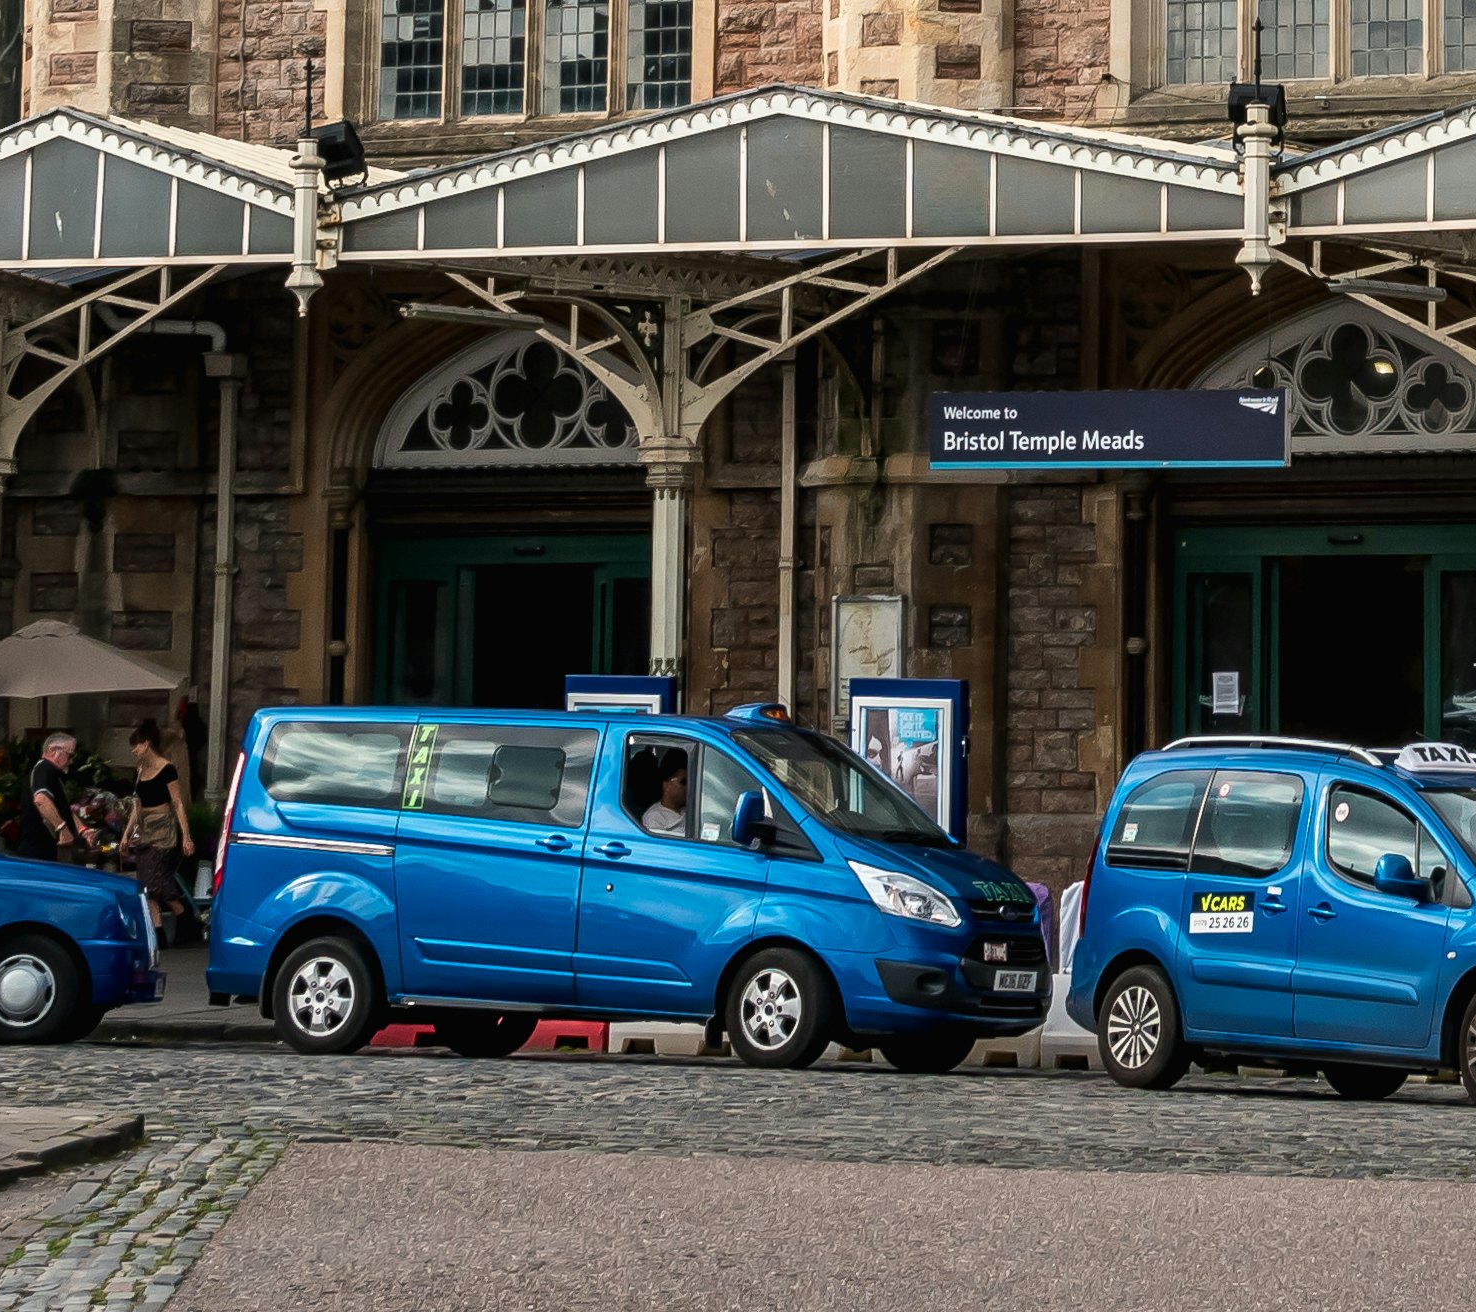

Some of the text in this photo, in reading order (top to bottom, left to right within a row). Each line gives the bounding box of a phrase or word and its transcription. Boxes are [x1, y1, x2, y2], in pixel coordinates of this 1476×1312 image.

[943, 406, 1018, 420] Welcome to
[943, 430, 1145, 455] Bristol Temple Meads
[1412, 747, 1472, 764] TAXI
[409, 726, 436, 806] TAXI
[972, 881, 1030, 903] TAXI
[1209, 917, 1221, 928] 25
[1223, 917, 1235, 928] 26
[1237, 917, 1249, 928] 26
